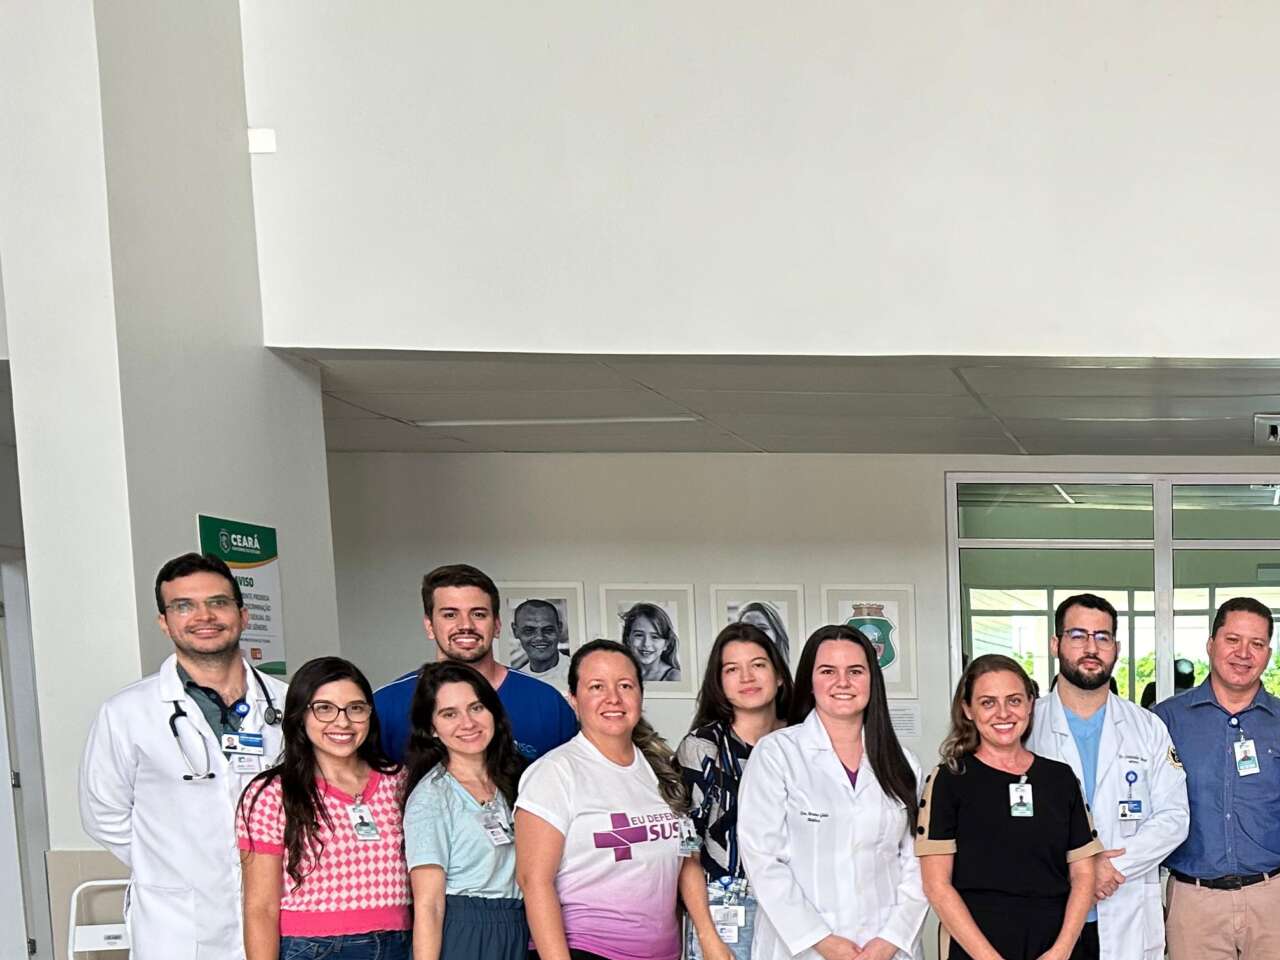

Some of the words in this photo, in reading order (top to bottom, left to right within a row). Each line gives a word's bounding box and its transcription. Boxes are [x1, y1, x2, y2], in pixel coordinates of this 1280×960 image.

[231, 533, 261, 550] CEARÁ
[631, 815, 645, 825] EU
[649, 822, 679, 841] SUS
